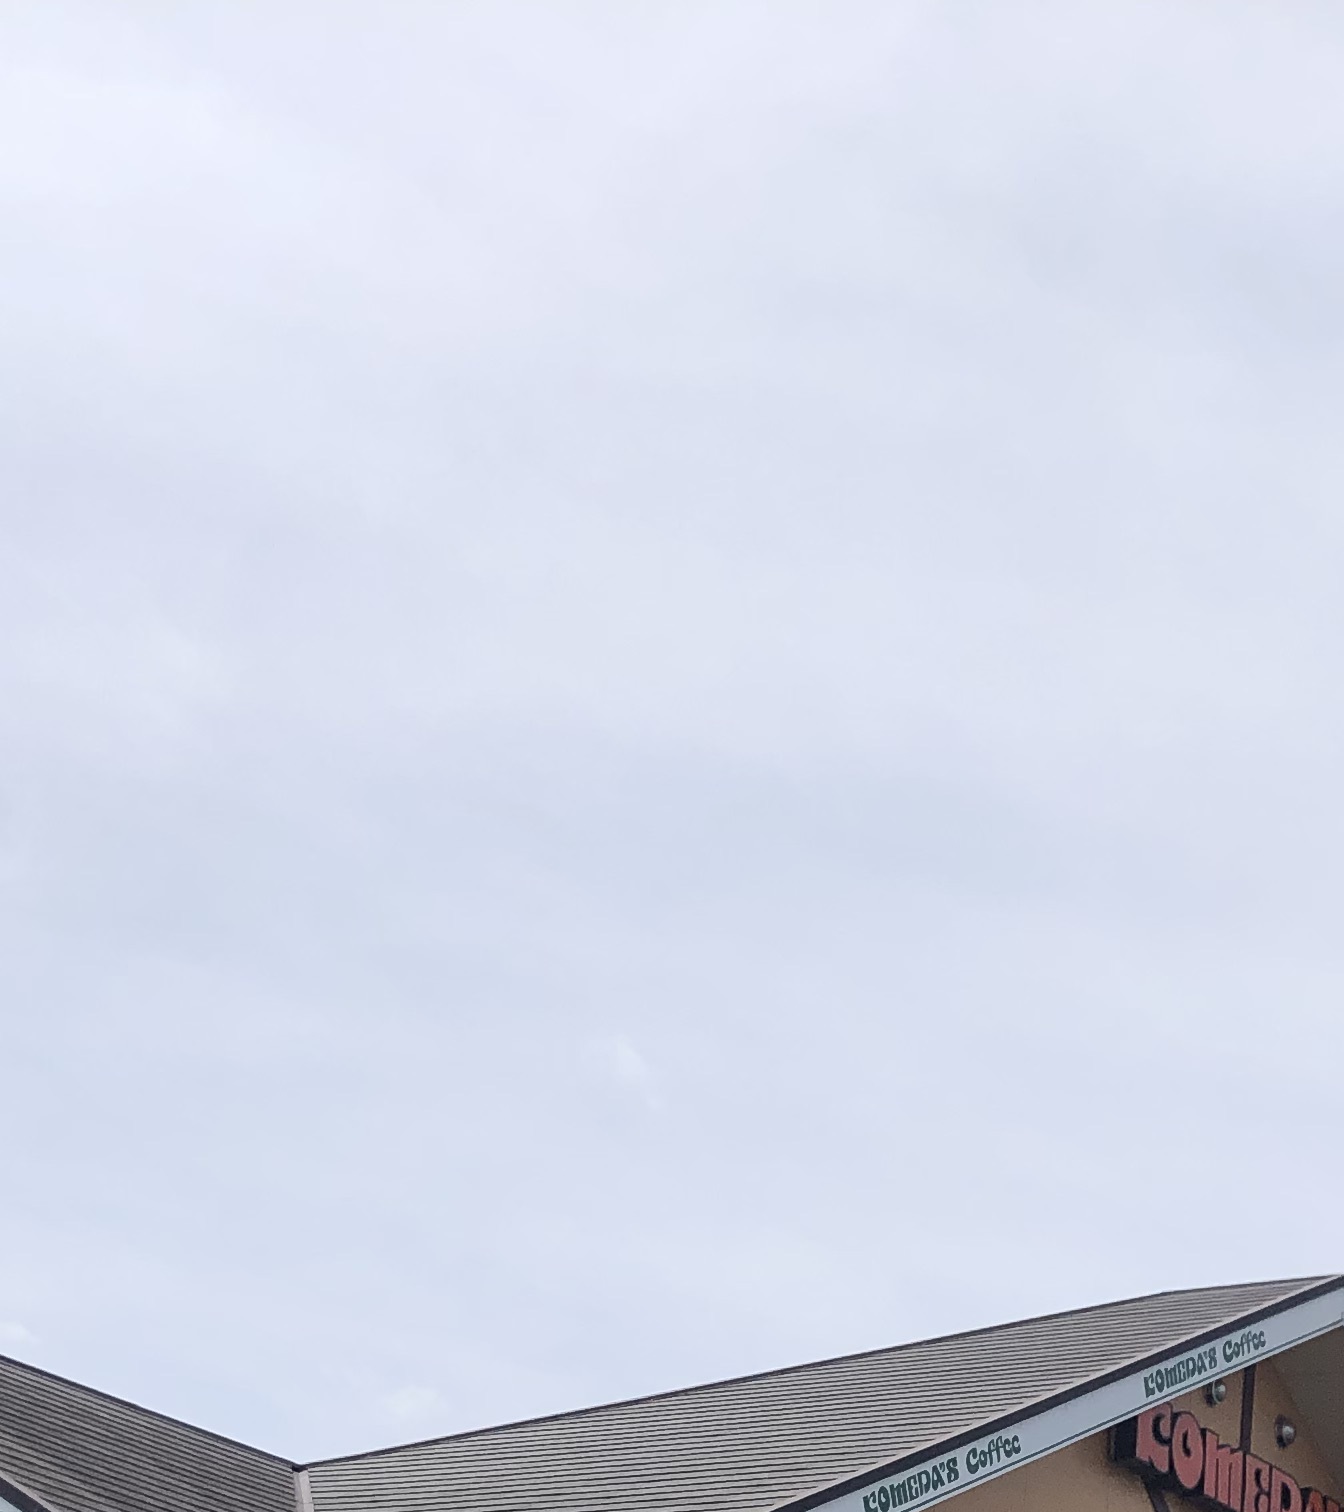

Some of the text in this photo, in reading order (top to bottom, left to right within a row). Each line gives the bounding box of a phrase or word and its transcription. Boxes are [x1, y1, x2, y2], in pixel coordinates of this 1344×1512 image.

[1143, 1329, 1267, 1398] KOMEDA'S Coffee
[965, 1432, 1023, 1473] Coffee
